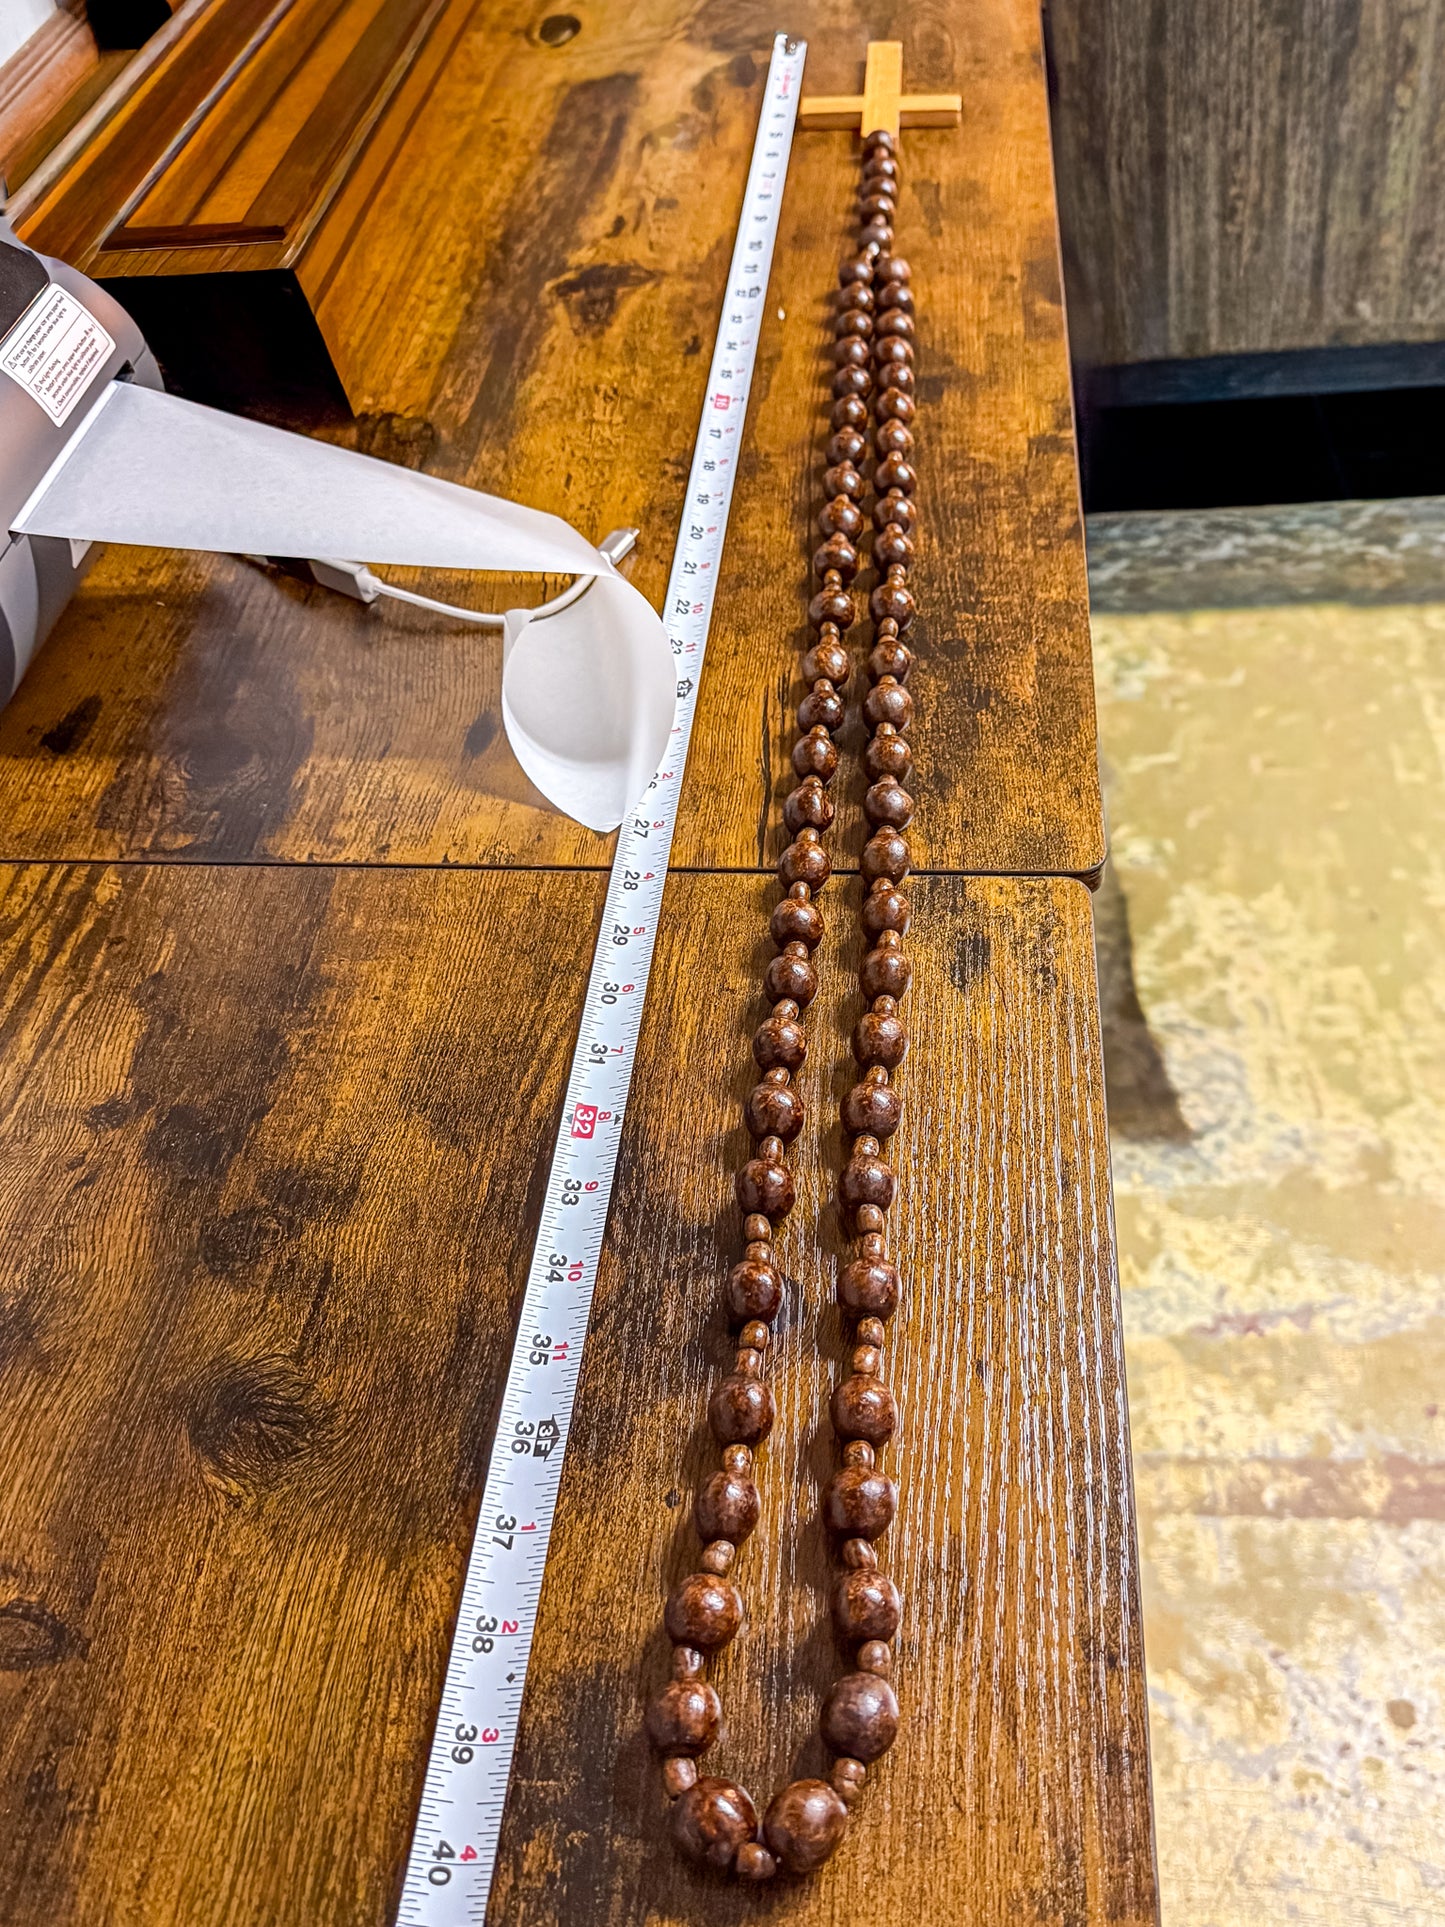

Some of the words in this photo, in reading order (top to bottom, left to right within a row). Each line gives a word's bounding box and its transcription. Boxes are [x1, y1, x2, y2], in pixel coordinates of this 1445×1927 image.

[709, 428, 722, 440] 17
[703, 460, 716, 472] 18
[697, 493, 710, 505] 19
[690, 525, 704, 540] 20
[683, 561, 697, 575] 21
[675, 598, 690, 615] 22
[692, 602, 704, 615] 10
[685, 642, 697, 653] 11
[662, 771, 674, 780] 2
[633, 818, 650, 839] 27
[653, 820, 665, 829] 3
[623, 869, 640, 891] 28
[643, 871, 655, 881] 4
[612, 923, 630, 946] 29
[633, 926, 646, 936] 5
[600, 981, 619, 1005] 30
[621, 983, 635, 993] 6
[588, 1042, 608, 1065] 31
[610, 1045, 624, 1055] 7
[572, 1108, 594, 1135] 32
[597, 1110, 612, 1122] 8
[560, 1178, 582, 1206] 33
[584, 1180, 599, 1192] 9
[545, 1252, 568, 1284] 34
[567, 1260, 584, 1282] 10
[528, 1333, 552, 1367] 35
[551, 1341, 570, 1361] 11
[510, 1419, 535, 1455] 36
[536, 1423, 554, 1453] 3F
[491, 1513, 517, 1551] 37
[520, 1521, 537, 1532] 1
[471, 1614, 499, 1654] 38
[501, 1619, 519, 1634] 2
[450, 1722, 478, 1765] 39
[481, 1727, 500, 1743] 3
[459, 1844, 478, 1862] 4
[427, 1839, 457, 1887] 40
